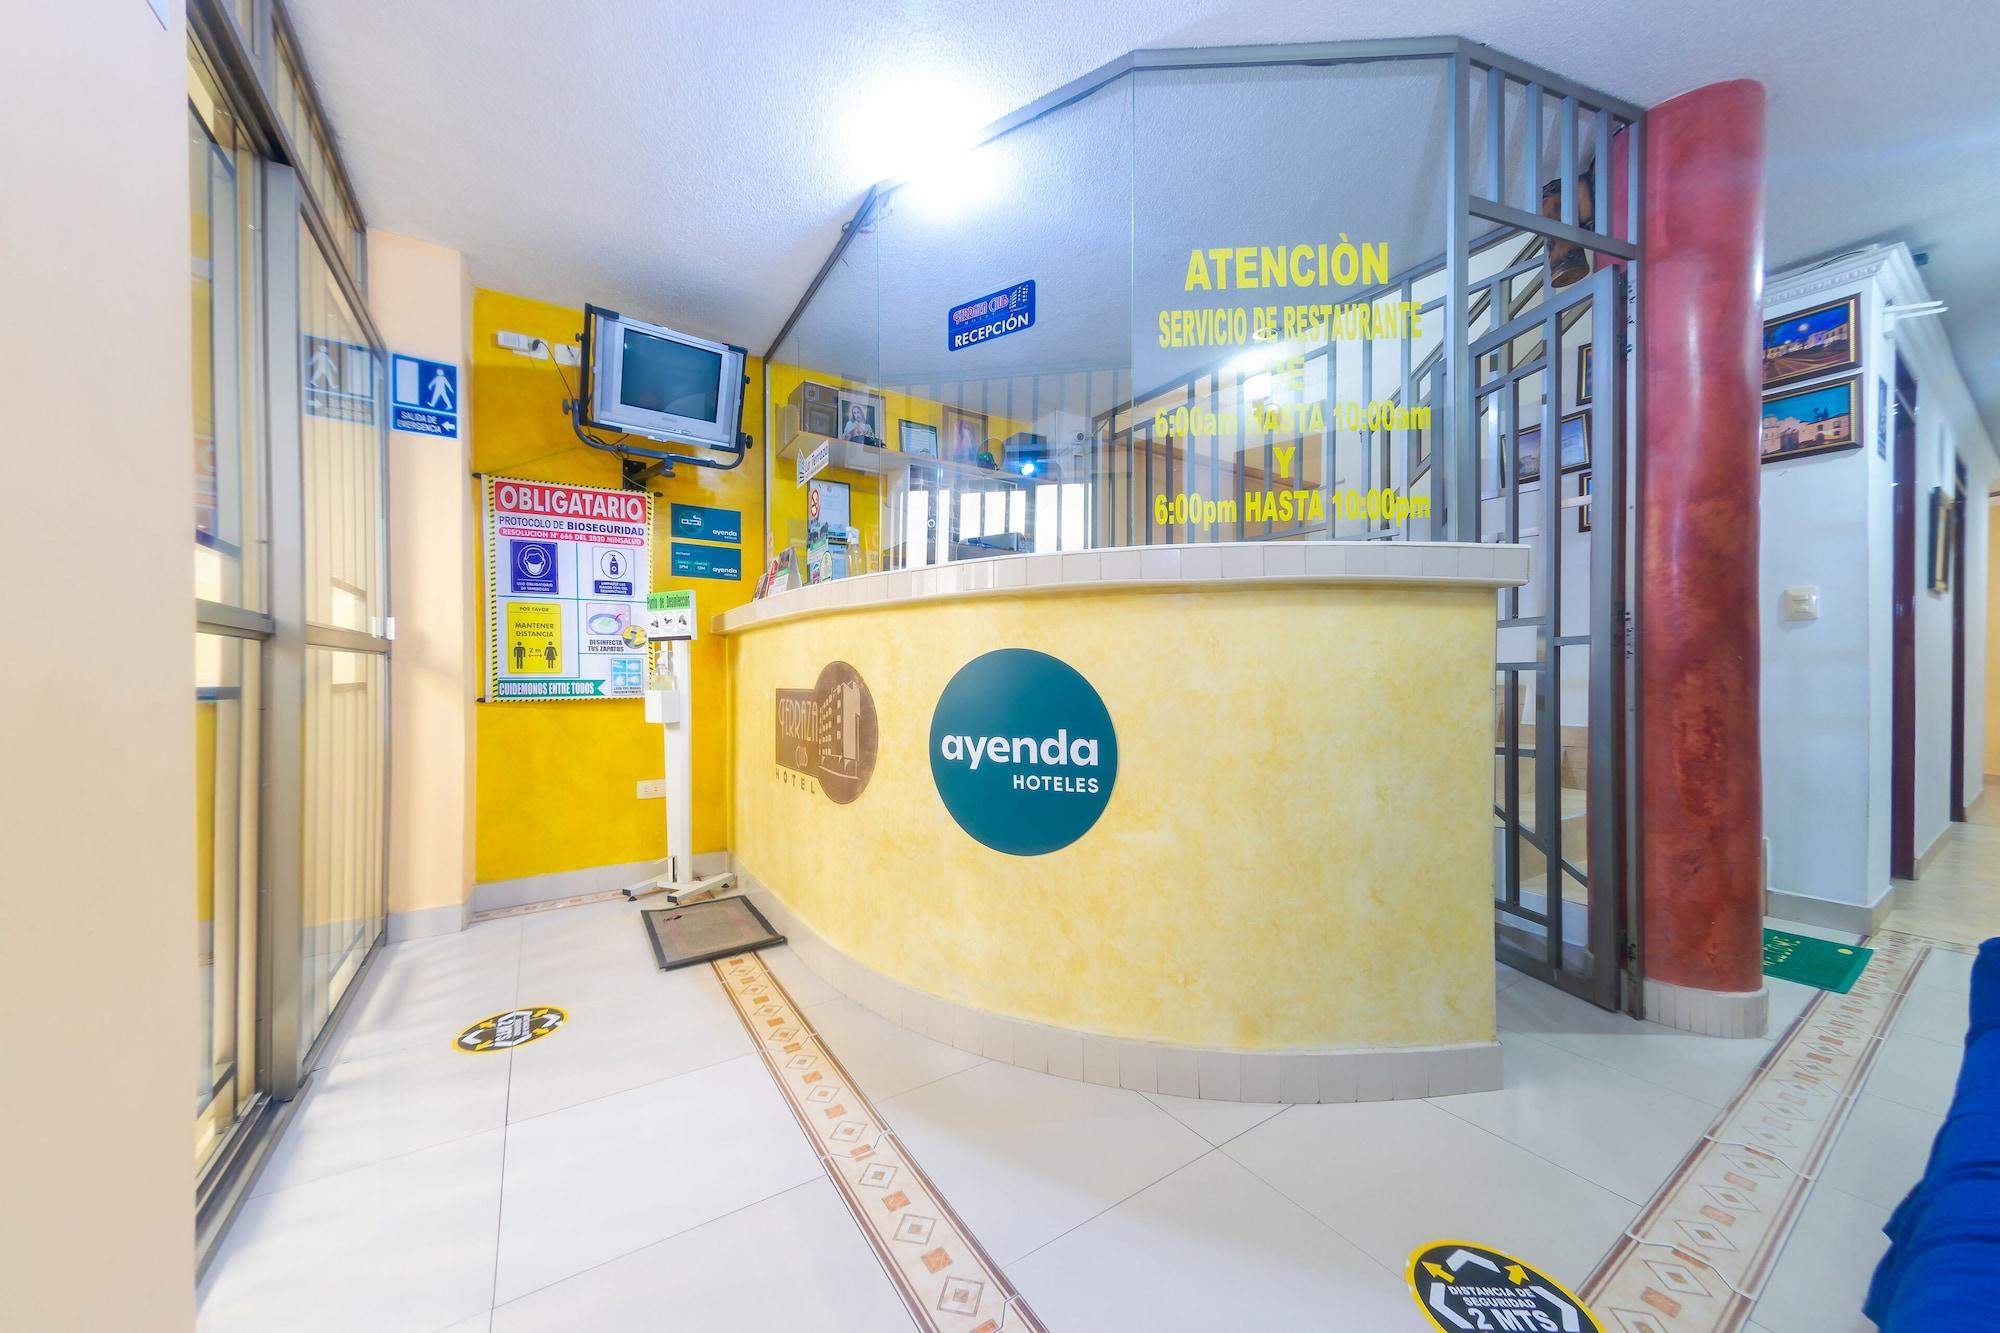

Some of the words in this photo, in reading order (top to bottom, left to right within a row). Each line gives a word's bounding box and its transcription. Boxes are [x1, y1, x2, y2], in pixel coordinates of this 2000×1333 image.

[1184, 231, 1388, 291] ATENCIÒN
[955, 312, 1029, 348] RECEPCIÓN
[1159, 306, 1247, 348] SERVICIO
[1253, 306, 1278, 342] DE
[1283, 301, 1422, 342] RESTAURANTE
[397, 420, 441, 433] EMERGENCIA
[400, 411, 425, 423] SALIDA
[426, 416, 438, 424] DE
[1155, 405, 1237, 438] 6:00am
[1333, 399, 1431, 432] 10:00am
[1273, 446, 1296, 479] Y
[500, 485, 643, 520] OBLIGATARIO
[1154, 493, 1237, 531] 6:00pm
[1245, 489, 1325, 522] HASTA
[1332, 488, 1431, 527] 10:00pm
[500, 516, 551, 529] PROTOCOLO
[553, 520, 567, 529] DE
[567, 521, 644, 536] BIOSEGURIDAD
[502, 528, 550, 538] RESOLUCION
[606, 536, 641, 545] MINSALUD
[712, 529, 737, 537] ayenda
[500, 682, 547, 695] CUIDEMONOS
[548, 682, 570, 695] ENTRE
[571, 682, 595, 695] TODOS
[941, 728, 1099, 770] ayenda
[775, 767, 815, 795] HOTEL
[1012, 774, 1099, 794] HOTELES
[1446, 1285, 1516, 1298] DISTANCIA
[1514, 1287, 1537, 1298] DE
[1462, 1296, 1537, 1309] SEGURIDAD
[1467, 1307, 1495, 1330] 2
[1490, 1308, 1559, 1332] MTS
